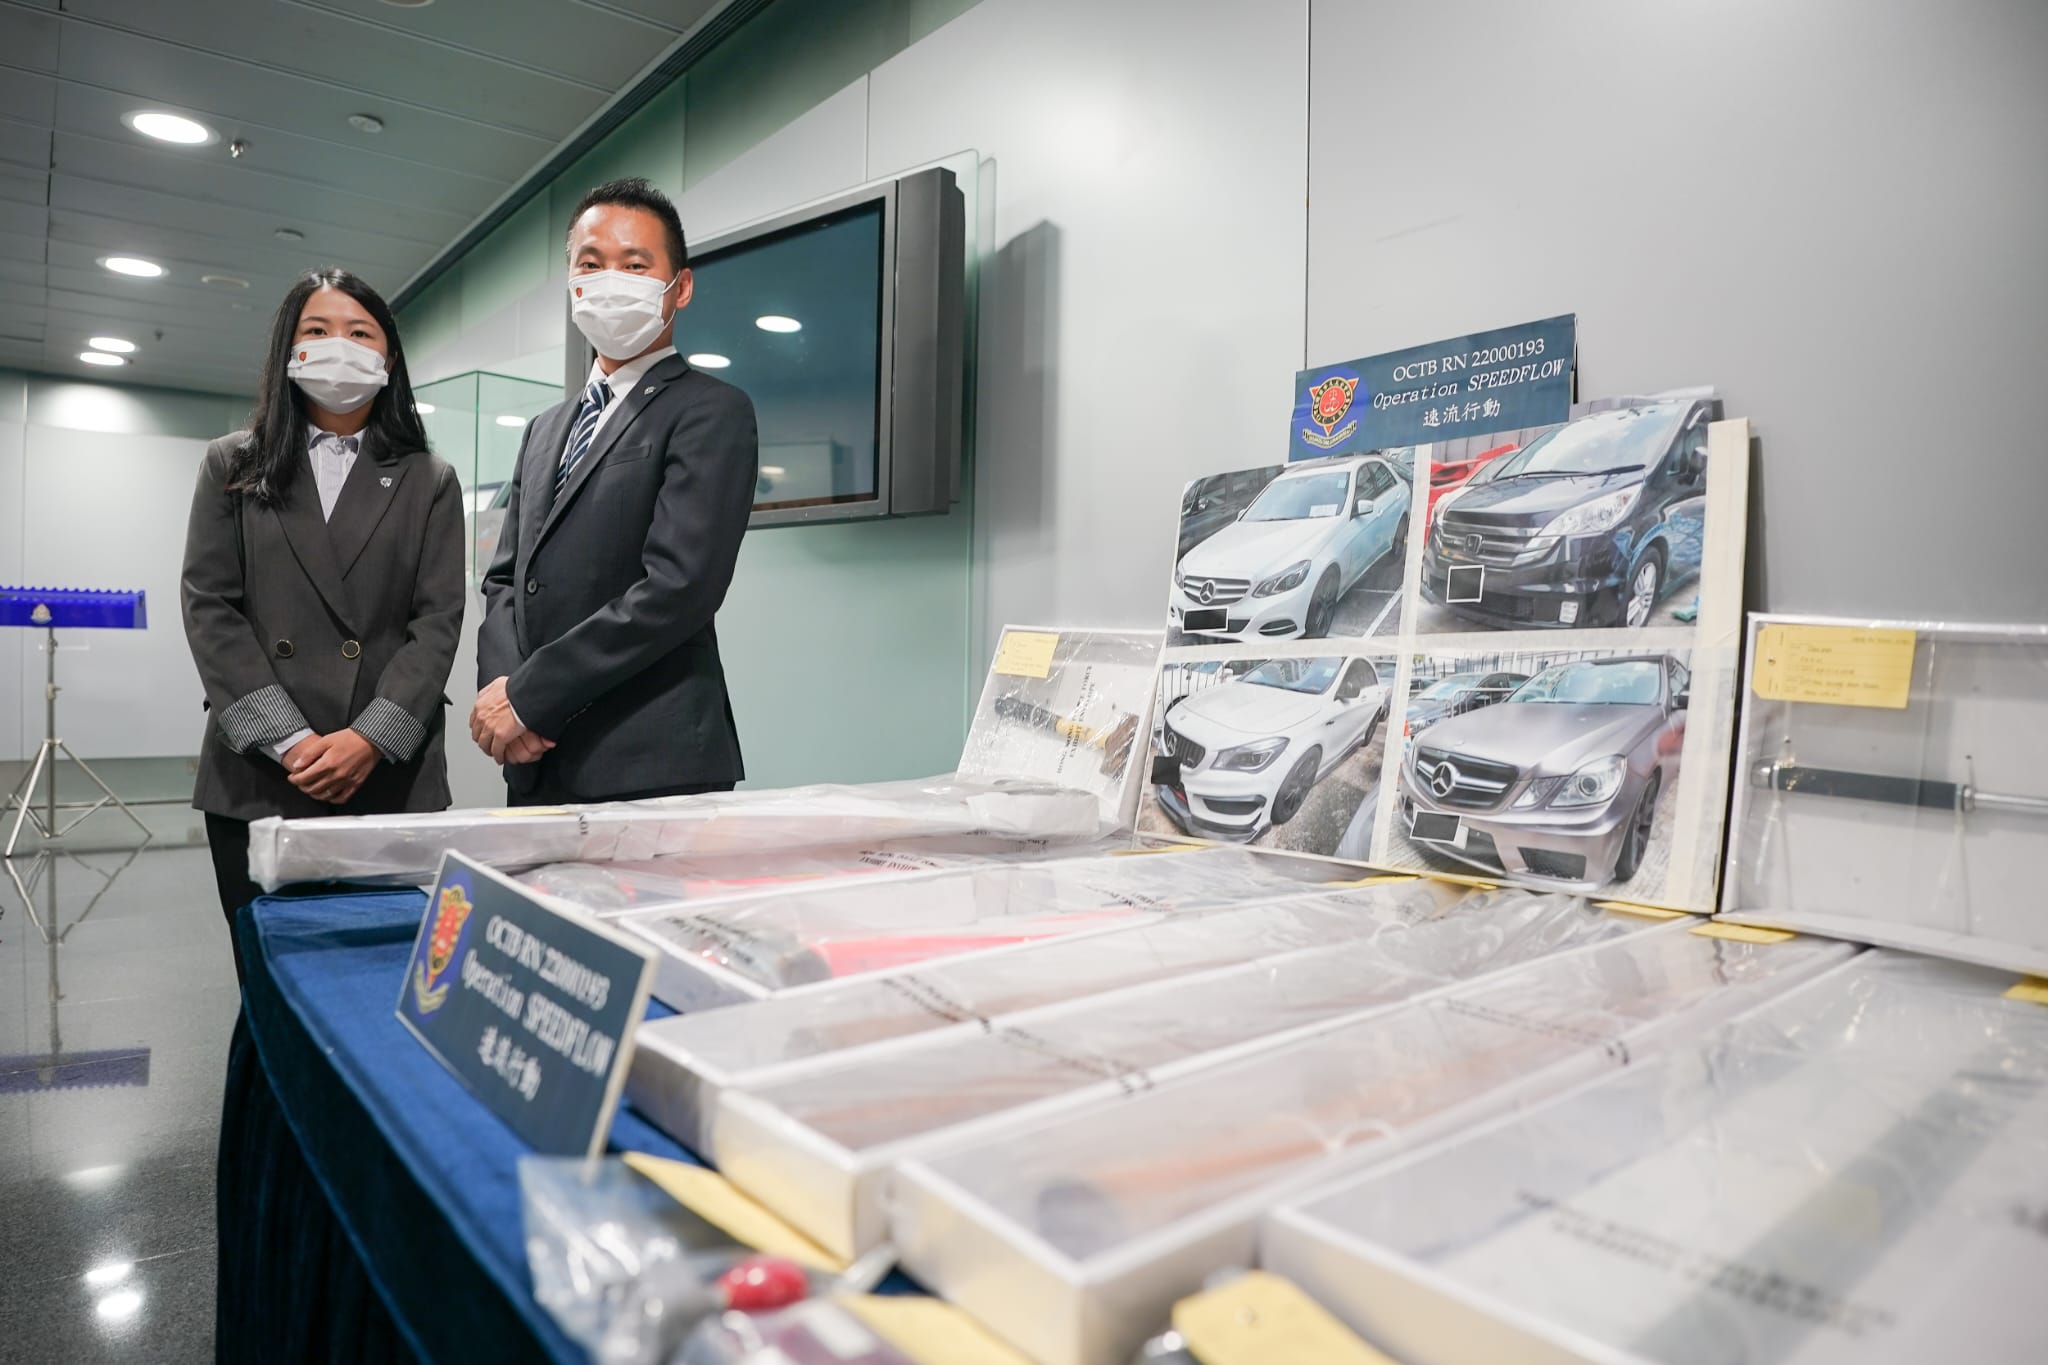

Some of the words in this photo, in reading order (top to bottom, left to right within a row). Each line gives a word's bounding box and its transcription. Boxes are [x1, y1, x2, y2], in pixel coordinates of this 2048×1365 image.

[1373, 383, 1458, 410] Operation
[1467, 358, 1566, 393] SPEEDFLOW
[1392, 362, 1438, 383] OCTB
[1441, 355, 1468, 373] RN
[1471, 337, 1545, 367] 22000193
